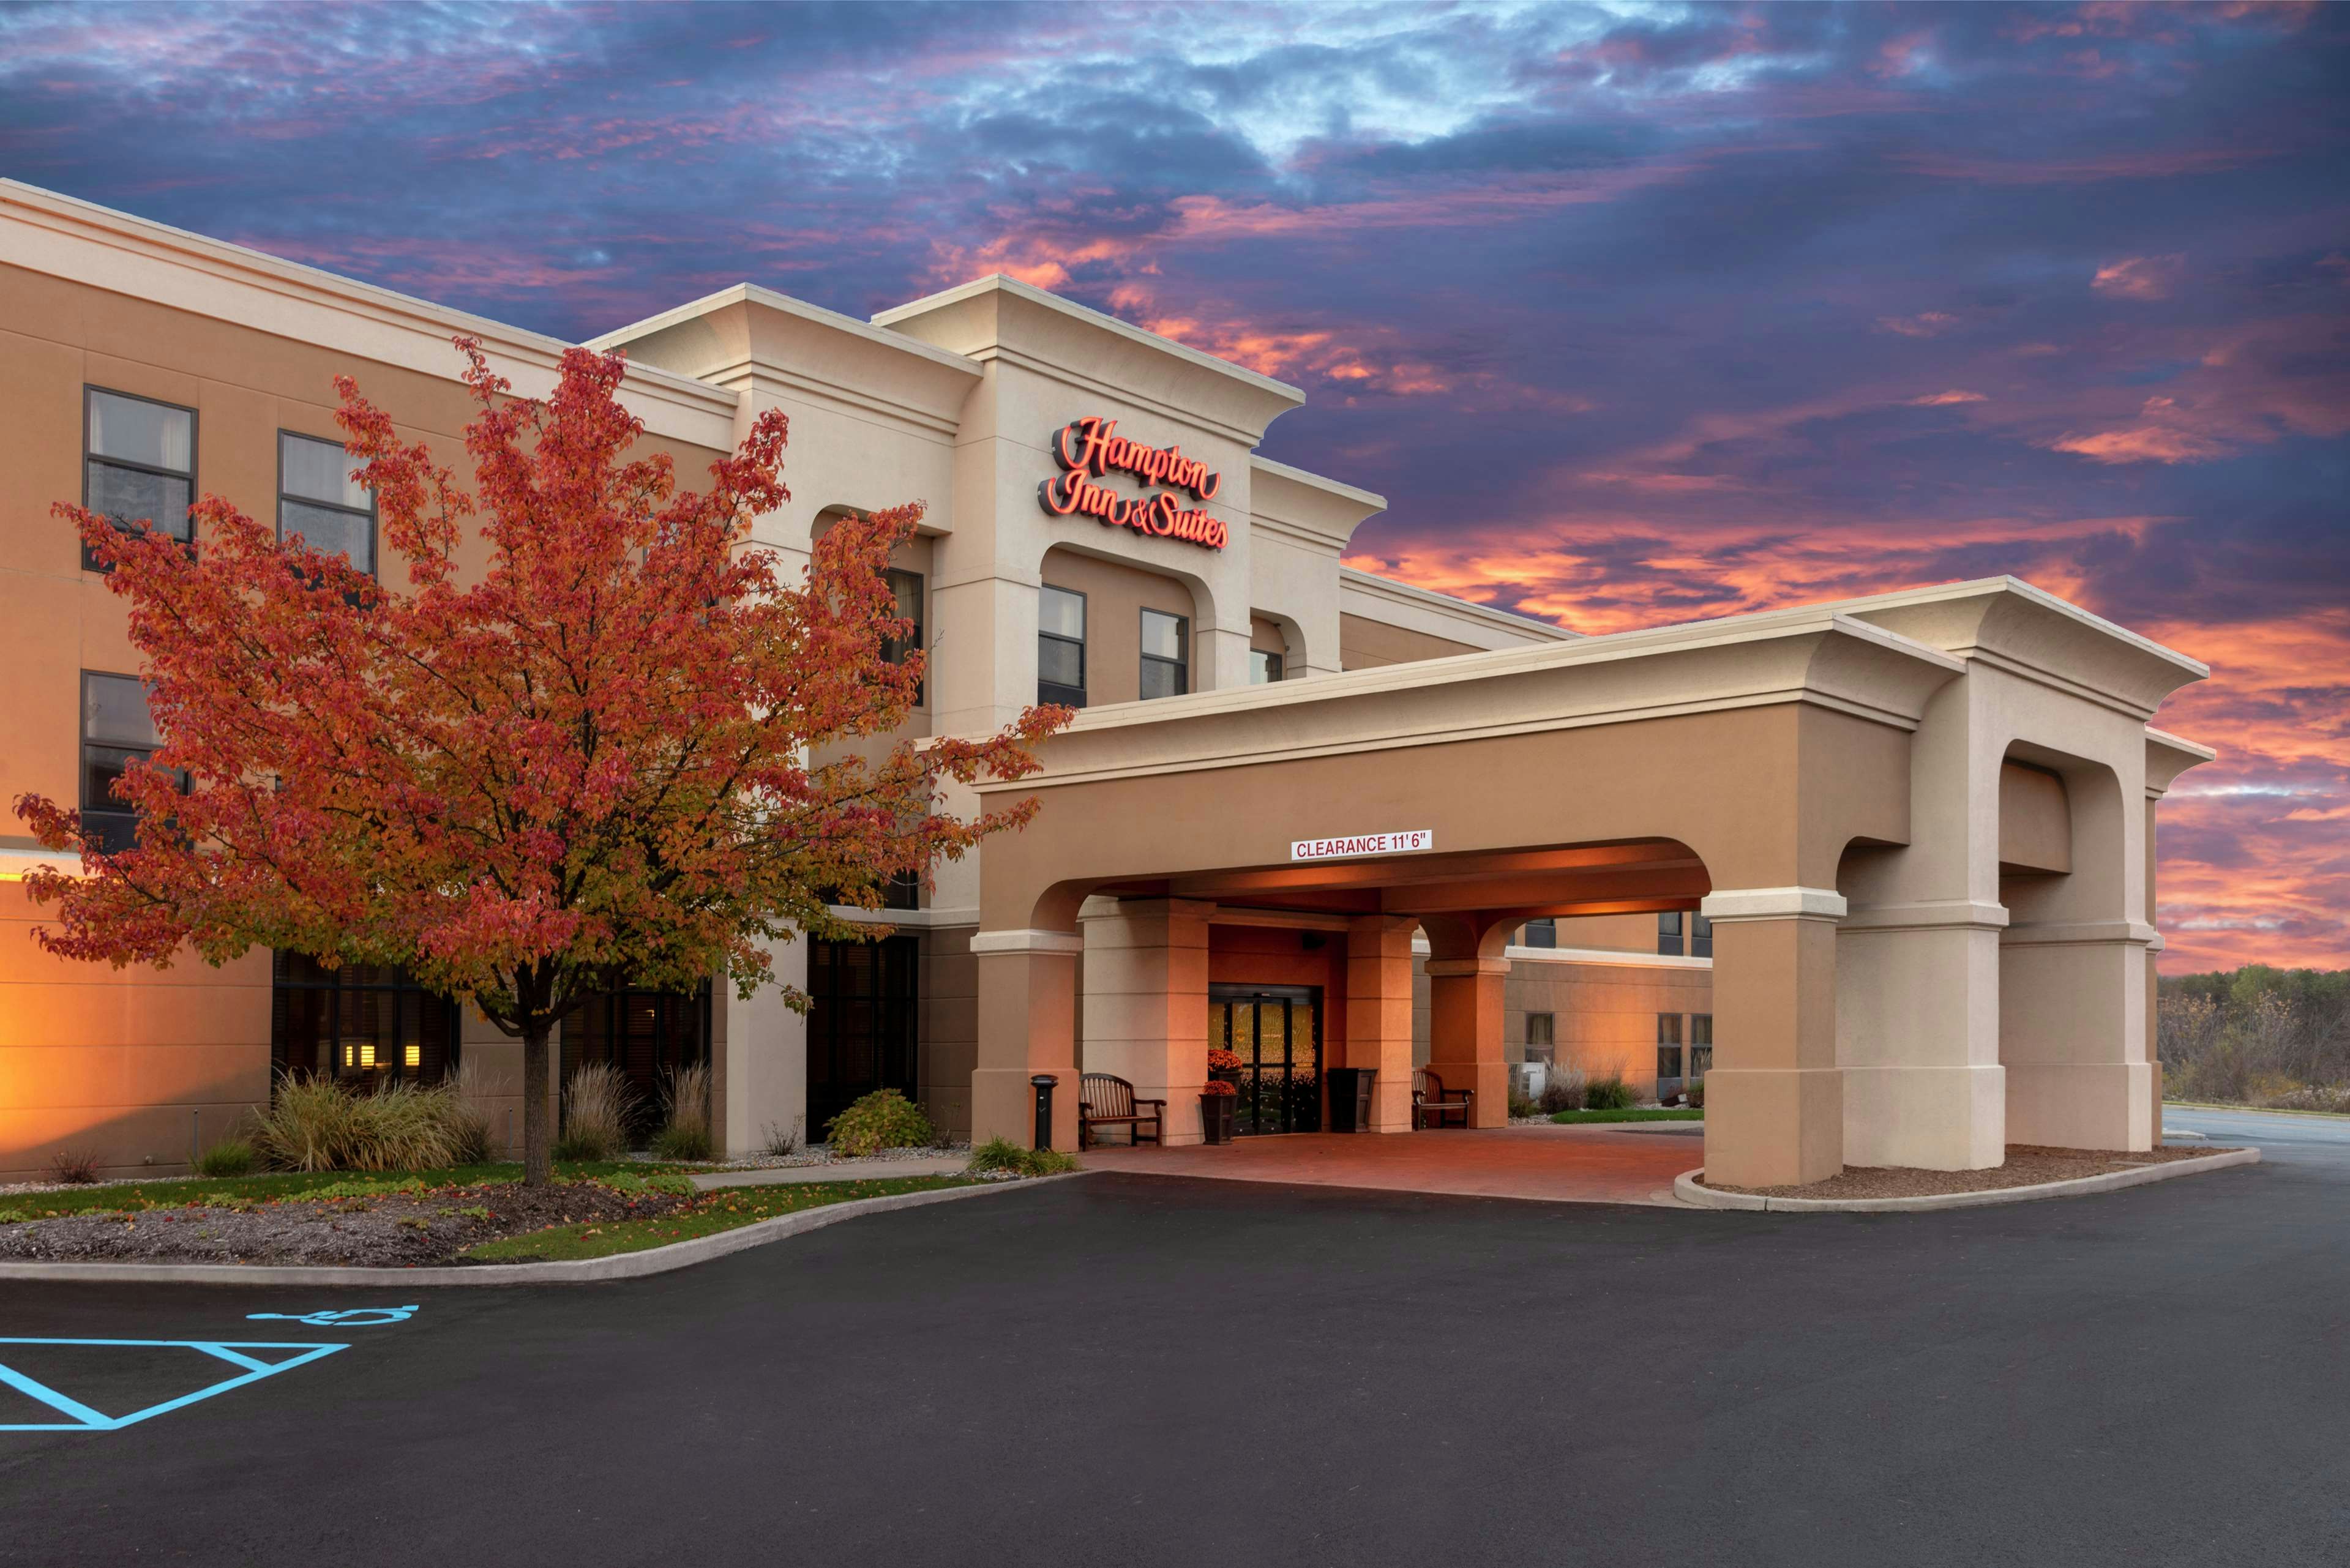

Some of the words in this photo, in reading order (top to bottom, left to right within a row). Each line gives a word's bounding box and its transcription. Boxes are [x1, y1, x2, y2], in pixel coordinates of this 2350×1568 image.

[1060, 416, 1221, 500] Hampton
[1046, 469, 1132, 525] Inn
[1149, 491, 1229, 549] Suites
[1297, 836, 1386, 858] CLEARANCE
